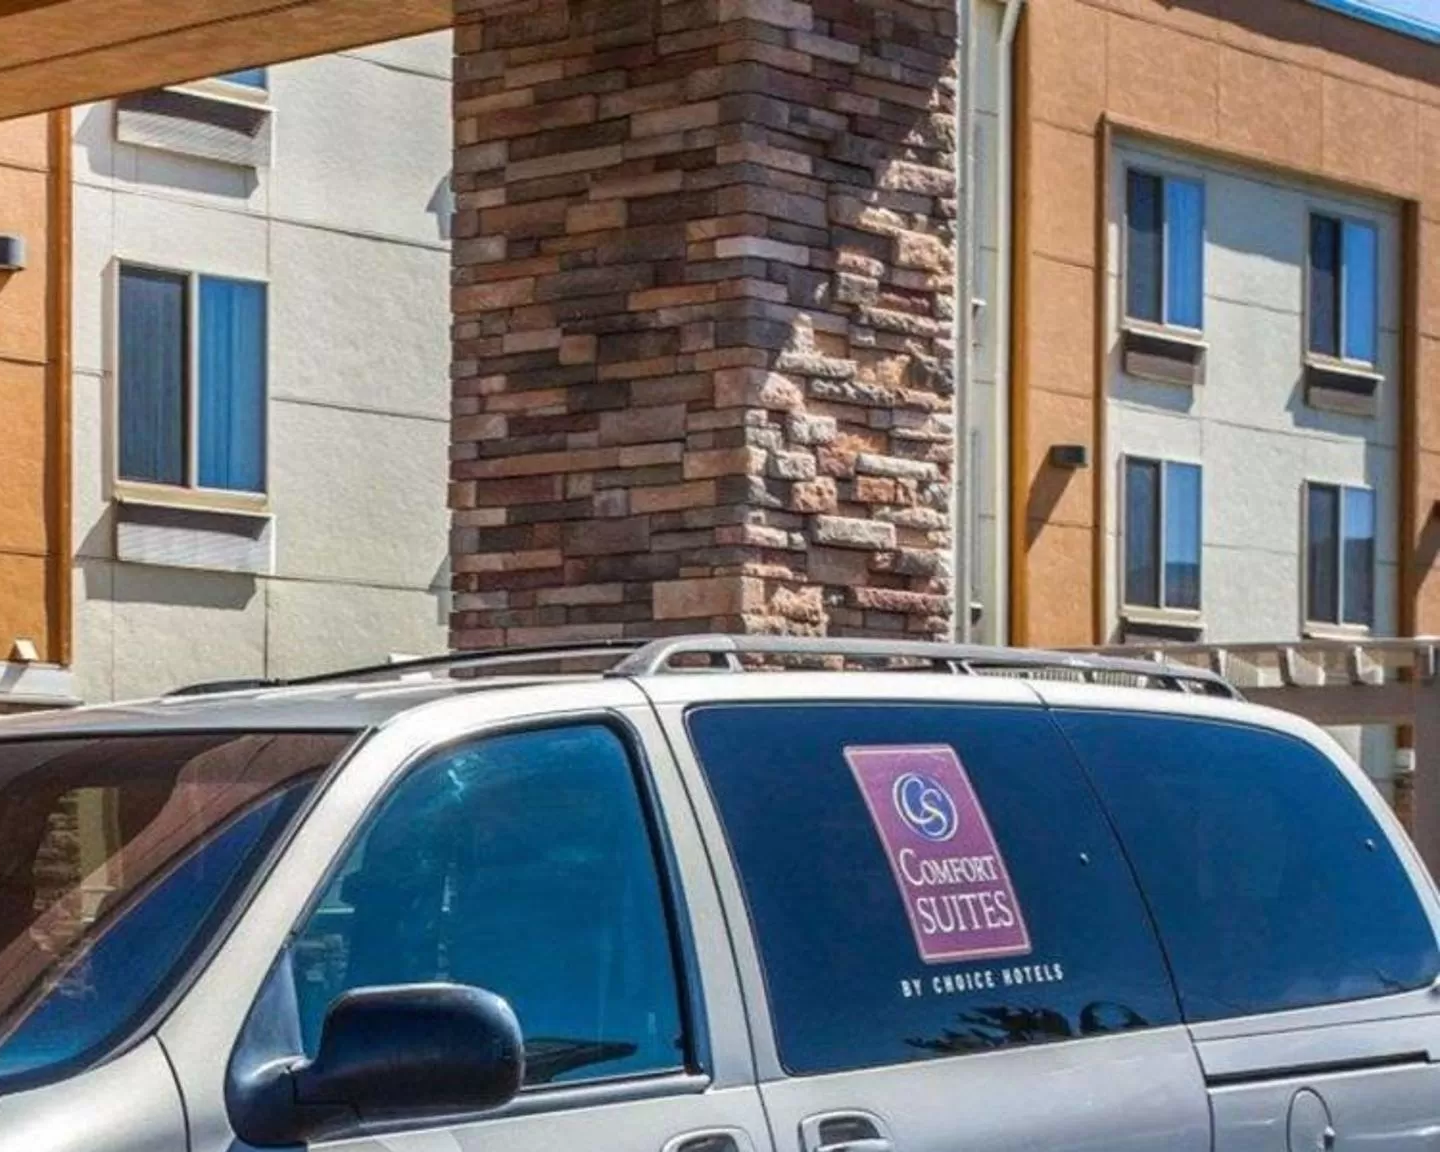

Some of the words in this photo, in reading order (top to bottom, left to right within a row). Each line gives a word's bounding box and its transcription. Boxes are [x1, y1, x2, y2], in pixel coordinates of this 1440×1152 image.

[899, 848, 999, 886] COMFORT
[916, 891, 1015, 934] SUITES
[901, 979, 923, 998] BY
[932, 970, 995, 994] CHOICE
[1004, 963, 1065, 986] HOTELS
